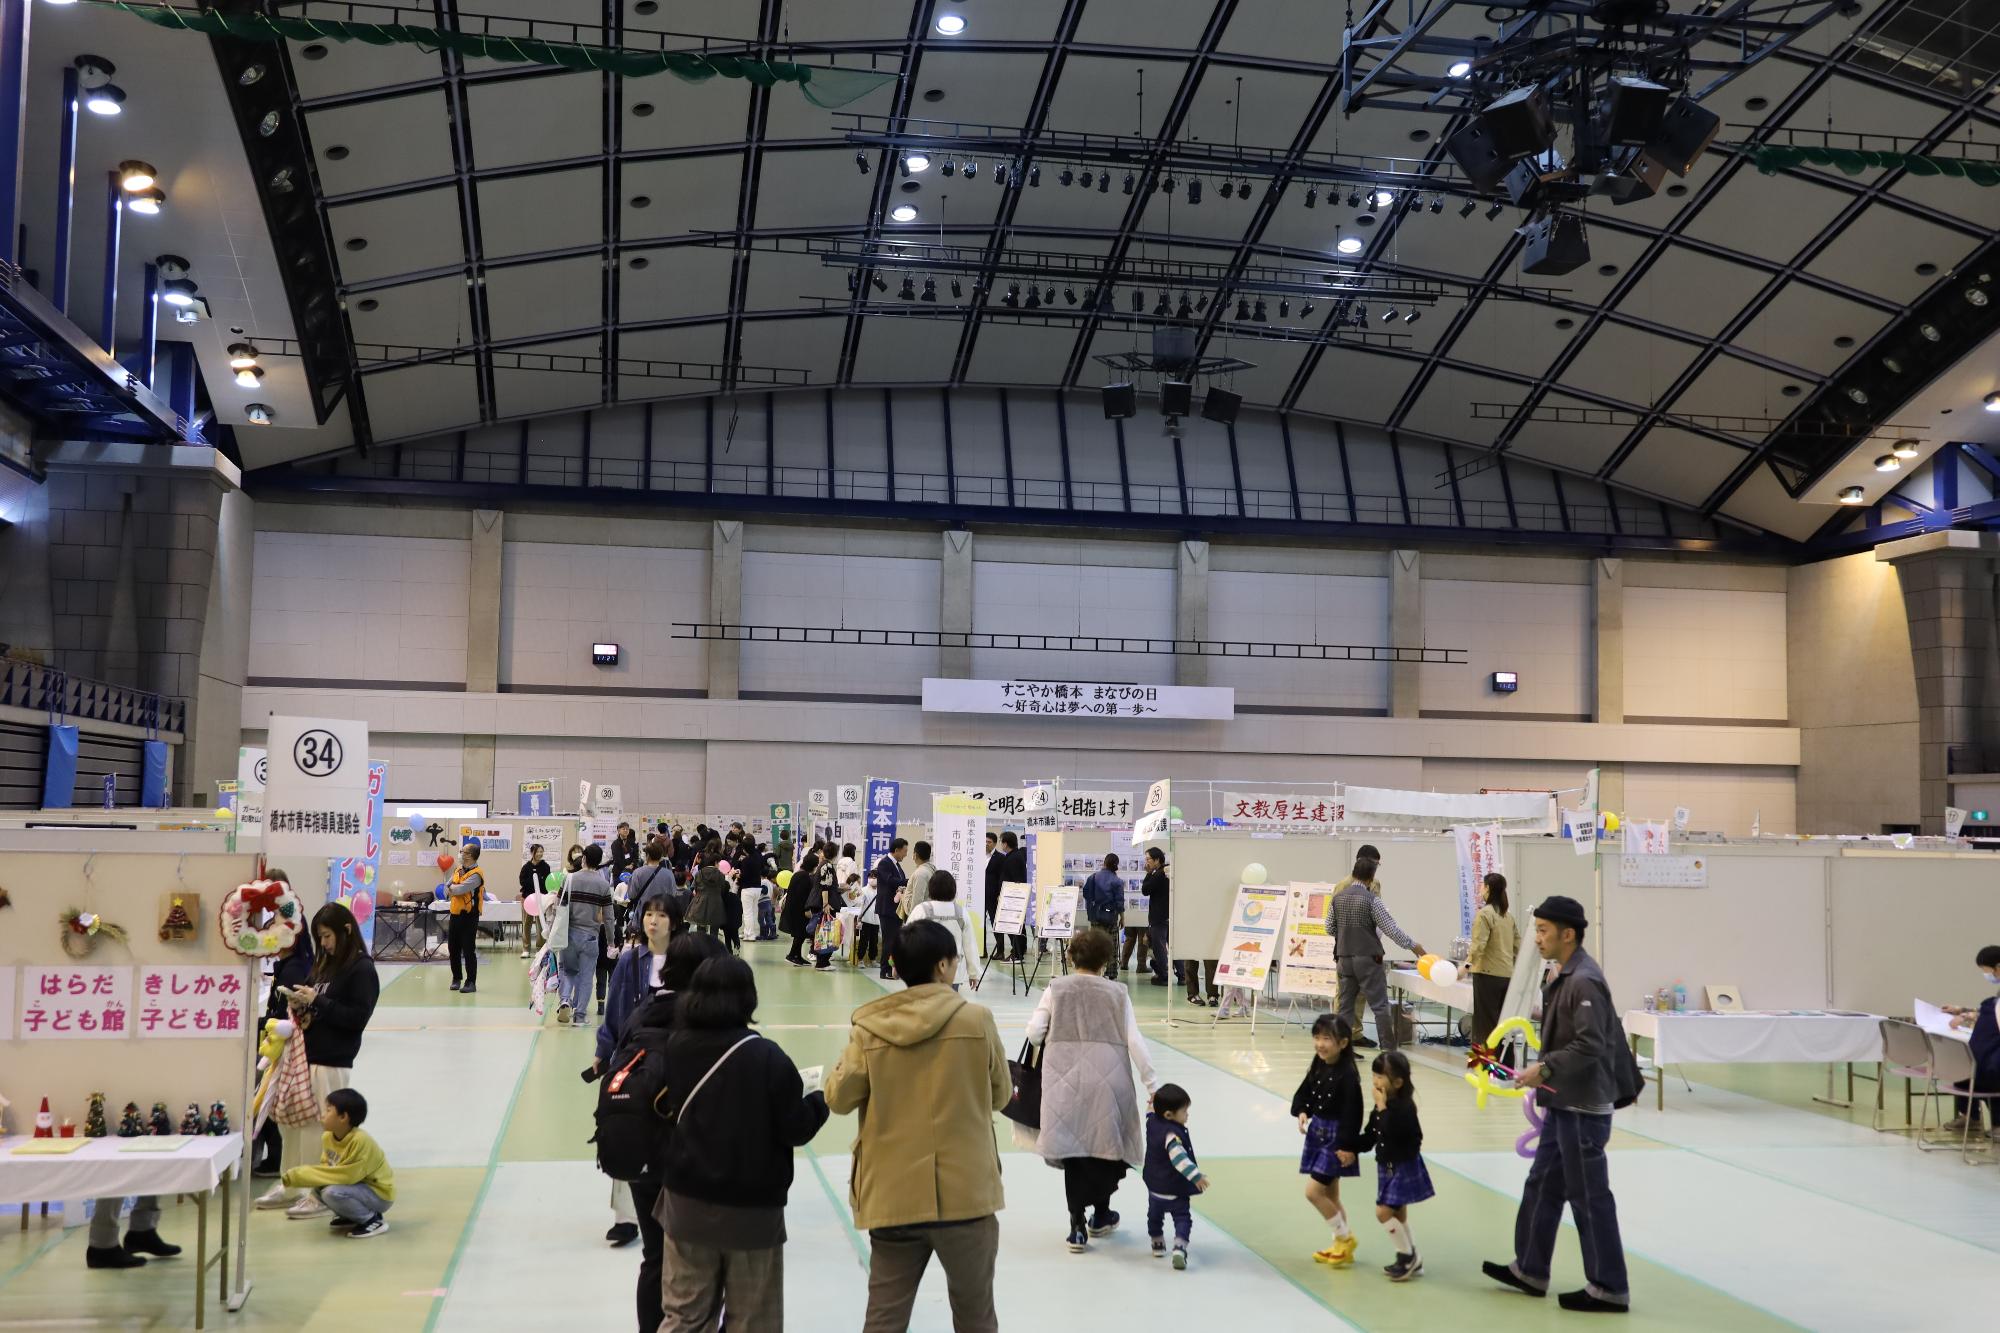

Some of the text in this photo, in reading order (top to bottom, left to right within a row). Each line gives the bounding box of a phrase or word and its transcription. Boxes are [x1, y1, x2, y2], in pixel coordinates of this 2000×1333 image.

[1001, 682, 1157, 701] すこやか橋本 まなびの日
[300, 735, 337, 771] 34
[602, 788, 613, 799] 30
[845, 790, 856, 801] 23
[1232, 799, 1344, 822] 文教厚生建設
[269, 810, 360, 834] 橋本市青年指導員連絡会
[1026, 816, 1056, 827] 橋本市議会
[40, 974, 114, 995] はらだ
[144, 974, 241, 995] きしかみ
[106, 1000, 123, 1008] かん
[221, 999, 238, 1007] かん
[24, 1009, 125, 1032] 子ども館
[140, 1008, 241, 1030] 子ども館
